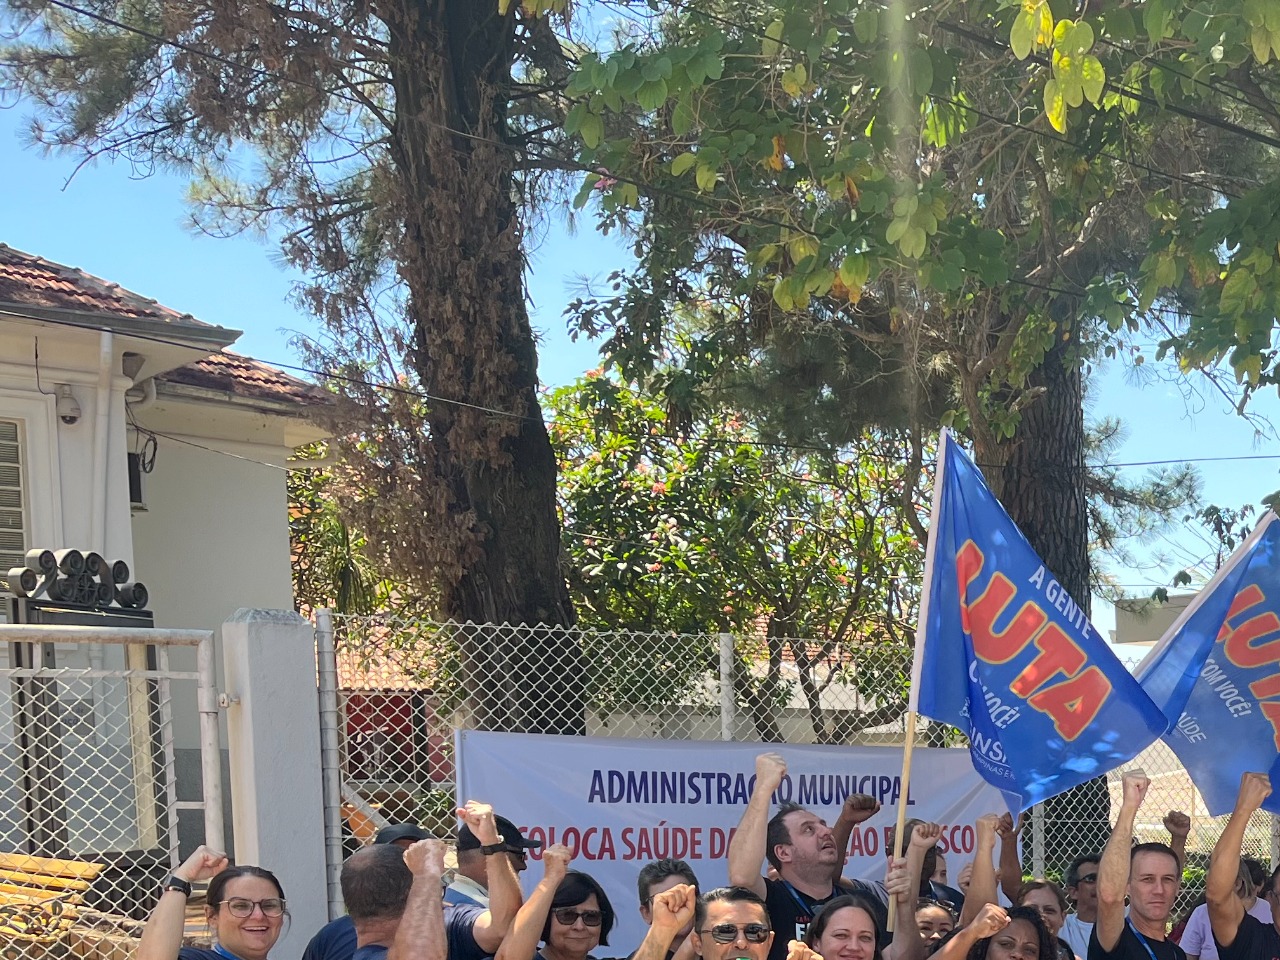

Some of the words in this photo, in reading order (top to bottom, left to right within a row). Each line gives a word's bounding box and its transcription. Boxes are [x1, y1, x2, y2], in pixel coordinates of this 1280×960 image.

[1028, 565, 1046, 591] A
[1045, 579, 1092, 640] GENTE
[1214, 674, 1252, 718] VOCÊ!
[588, 769, 793, 805] ADMINISTRAO
[621, 821, 703, 861] SAÚDE
